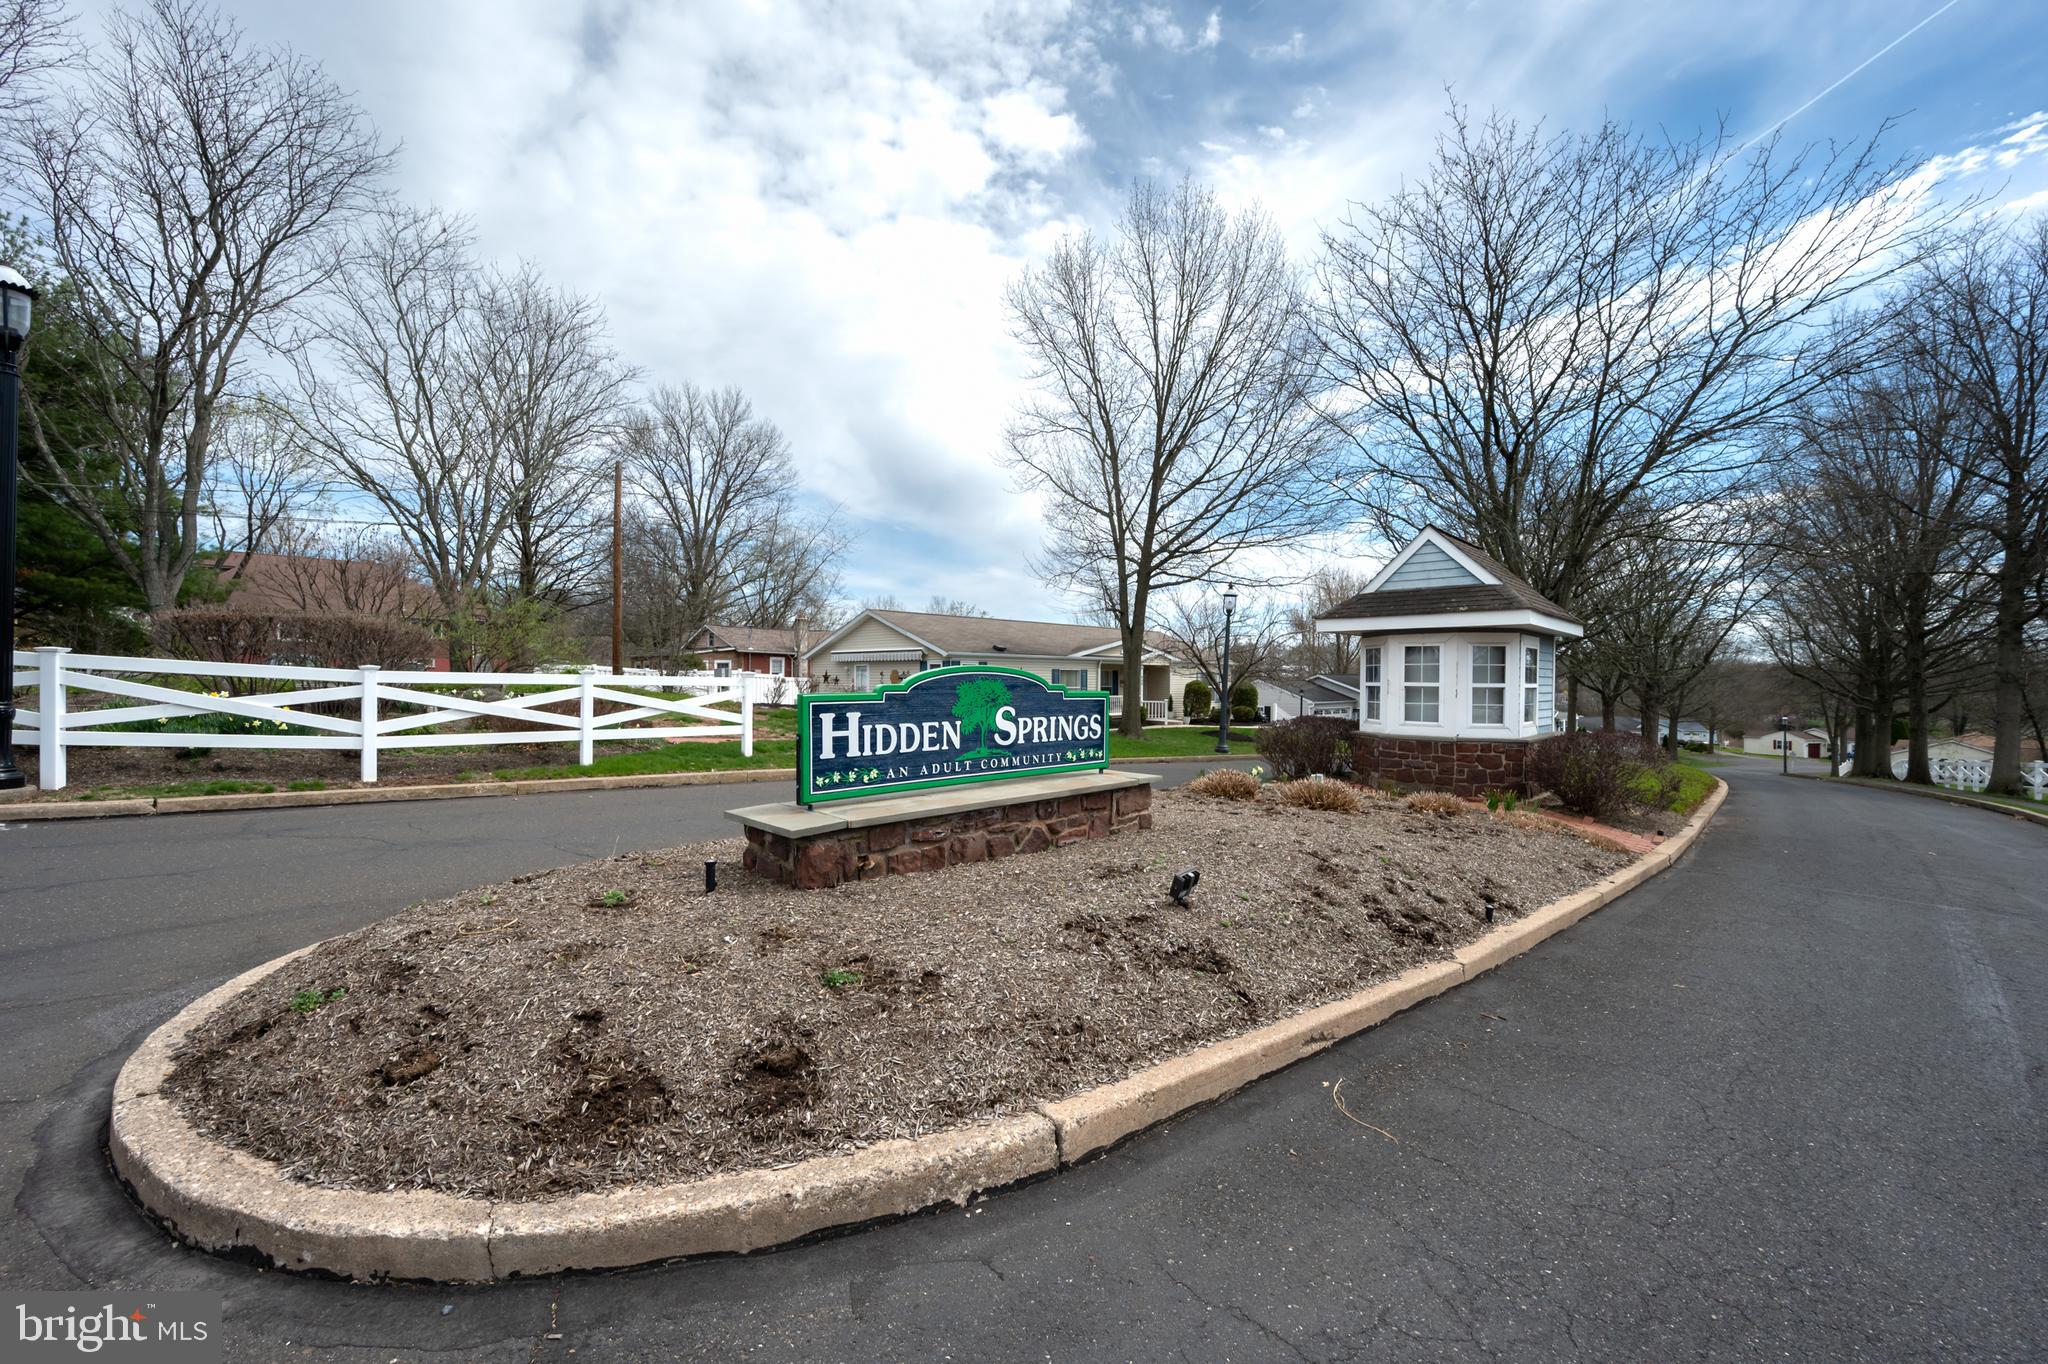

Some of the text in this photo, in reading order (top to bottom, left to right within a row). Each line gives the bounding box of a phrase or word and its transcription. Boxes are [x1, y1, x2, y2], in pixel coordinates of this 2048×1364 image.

[819, 706, 1102, 760] HIDDEN SPRINGS
[886, 752, 1062, 779] AN ADULT COMMUNITY
